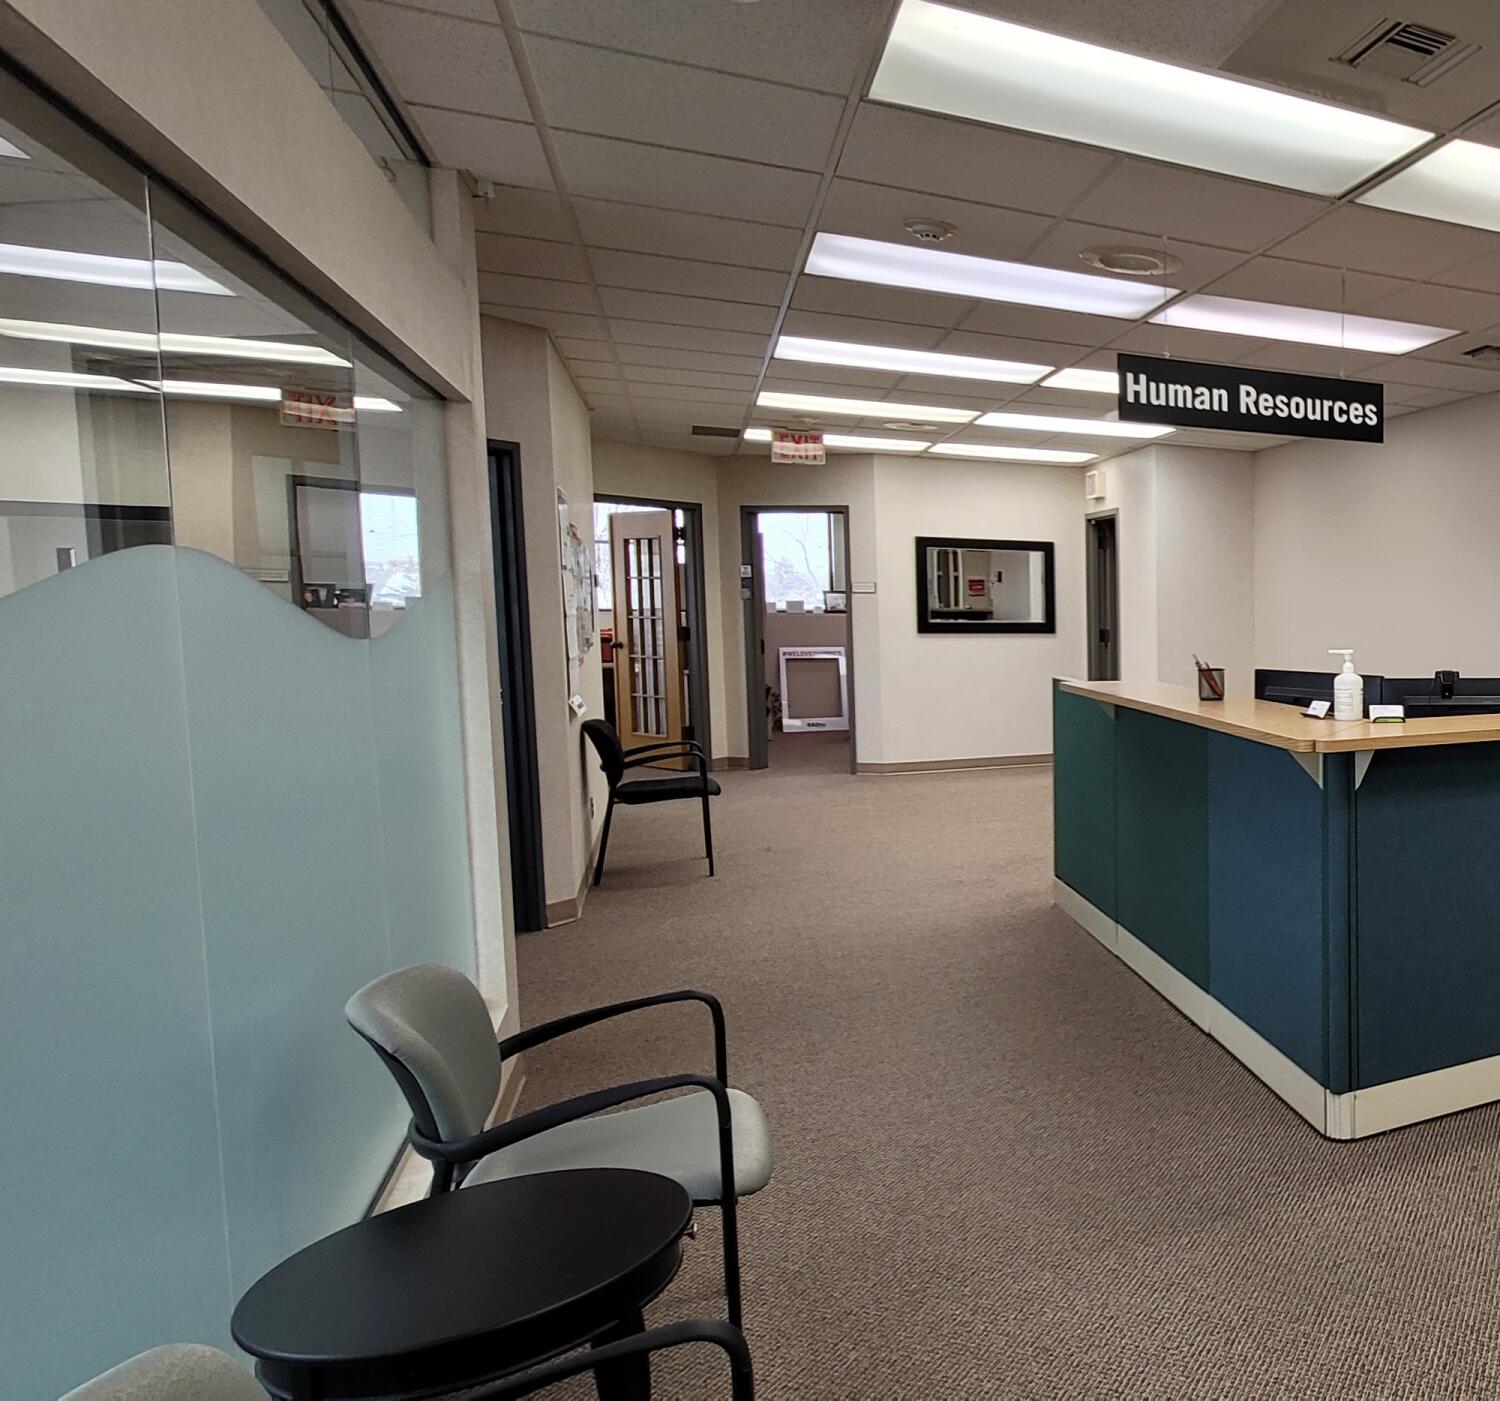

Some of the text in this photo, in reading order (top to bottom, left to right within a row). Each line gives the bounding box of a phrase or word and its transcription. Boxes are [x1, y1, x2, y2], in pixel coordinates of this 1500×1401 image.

[1126, 372, 1378, 426] Human Resources
[779, 432, 821, 461] EXIT
